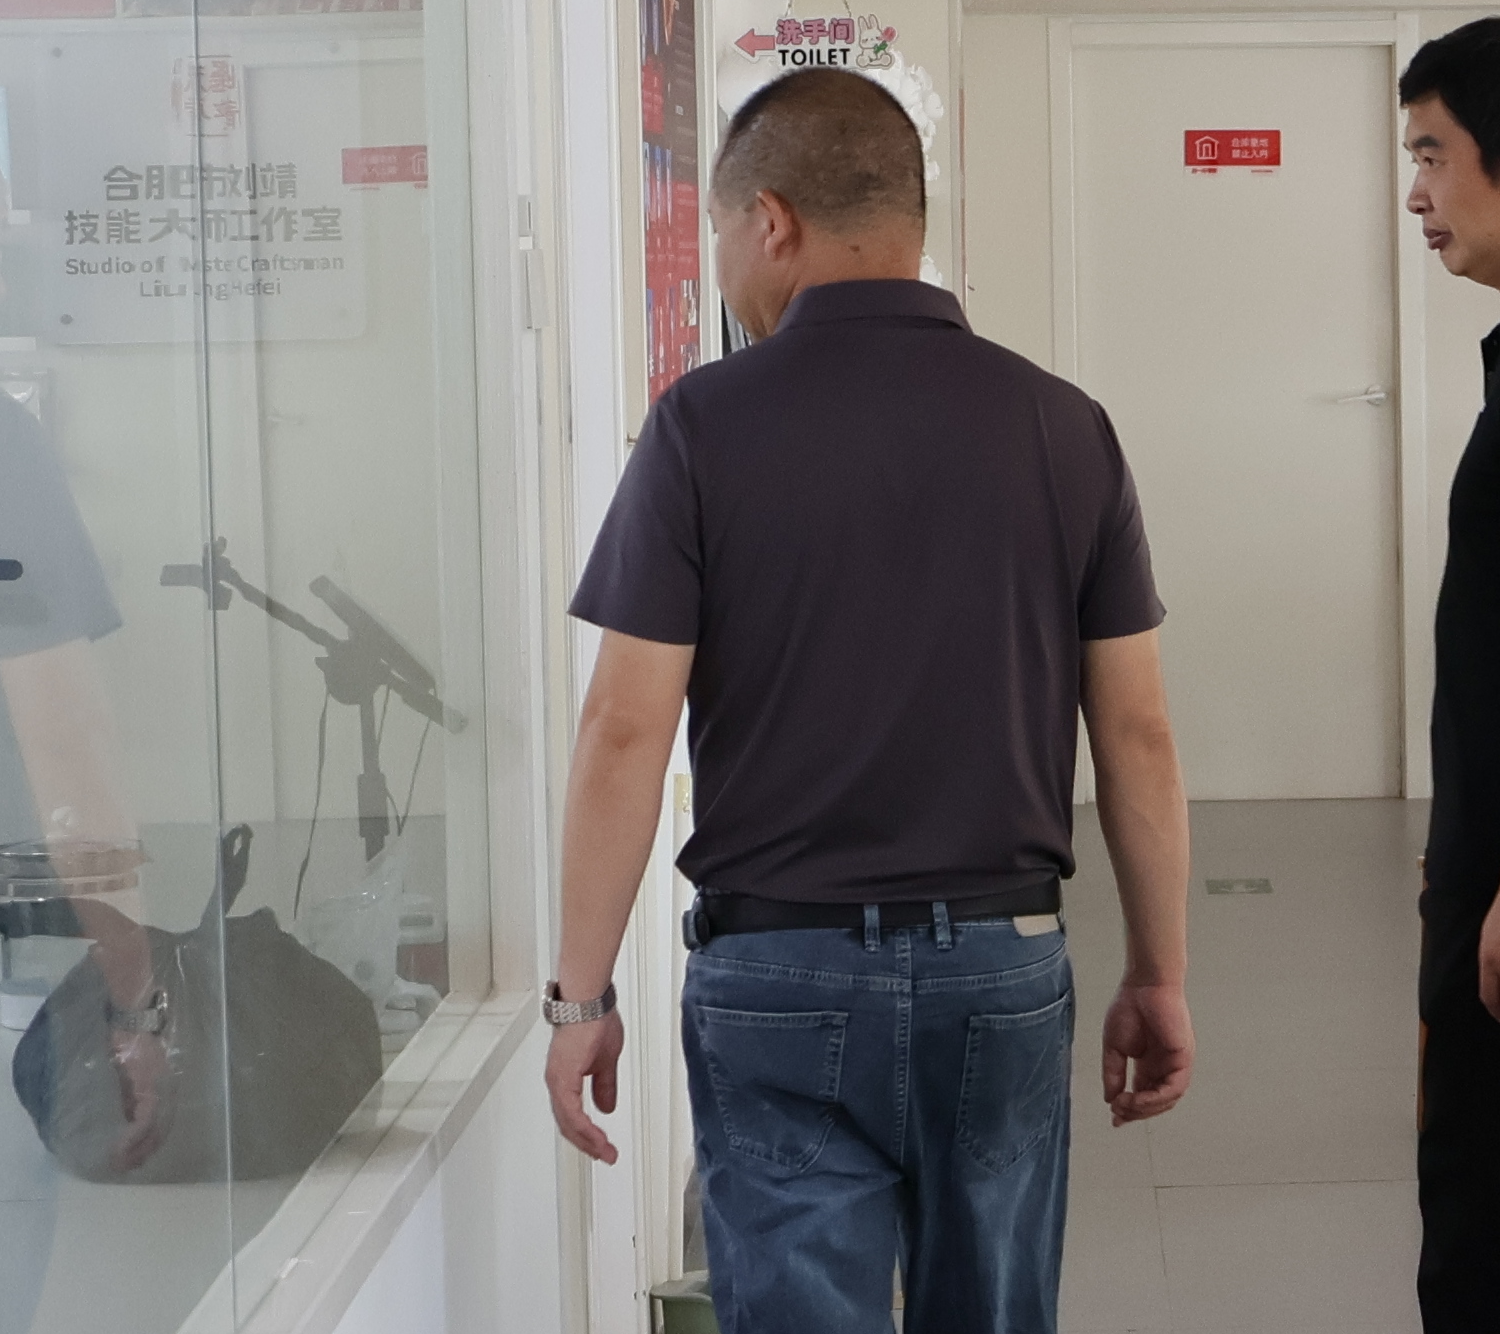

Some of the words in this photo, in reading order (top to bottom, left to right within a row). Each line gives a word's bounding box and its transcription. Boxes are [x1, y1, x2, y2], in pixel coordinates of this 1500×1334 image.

[776, 17, 854, 45] 洗手间
[778, 48, 851, 66] TOILET
